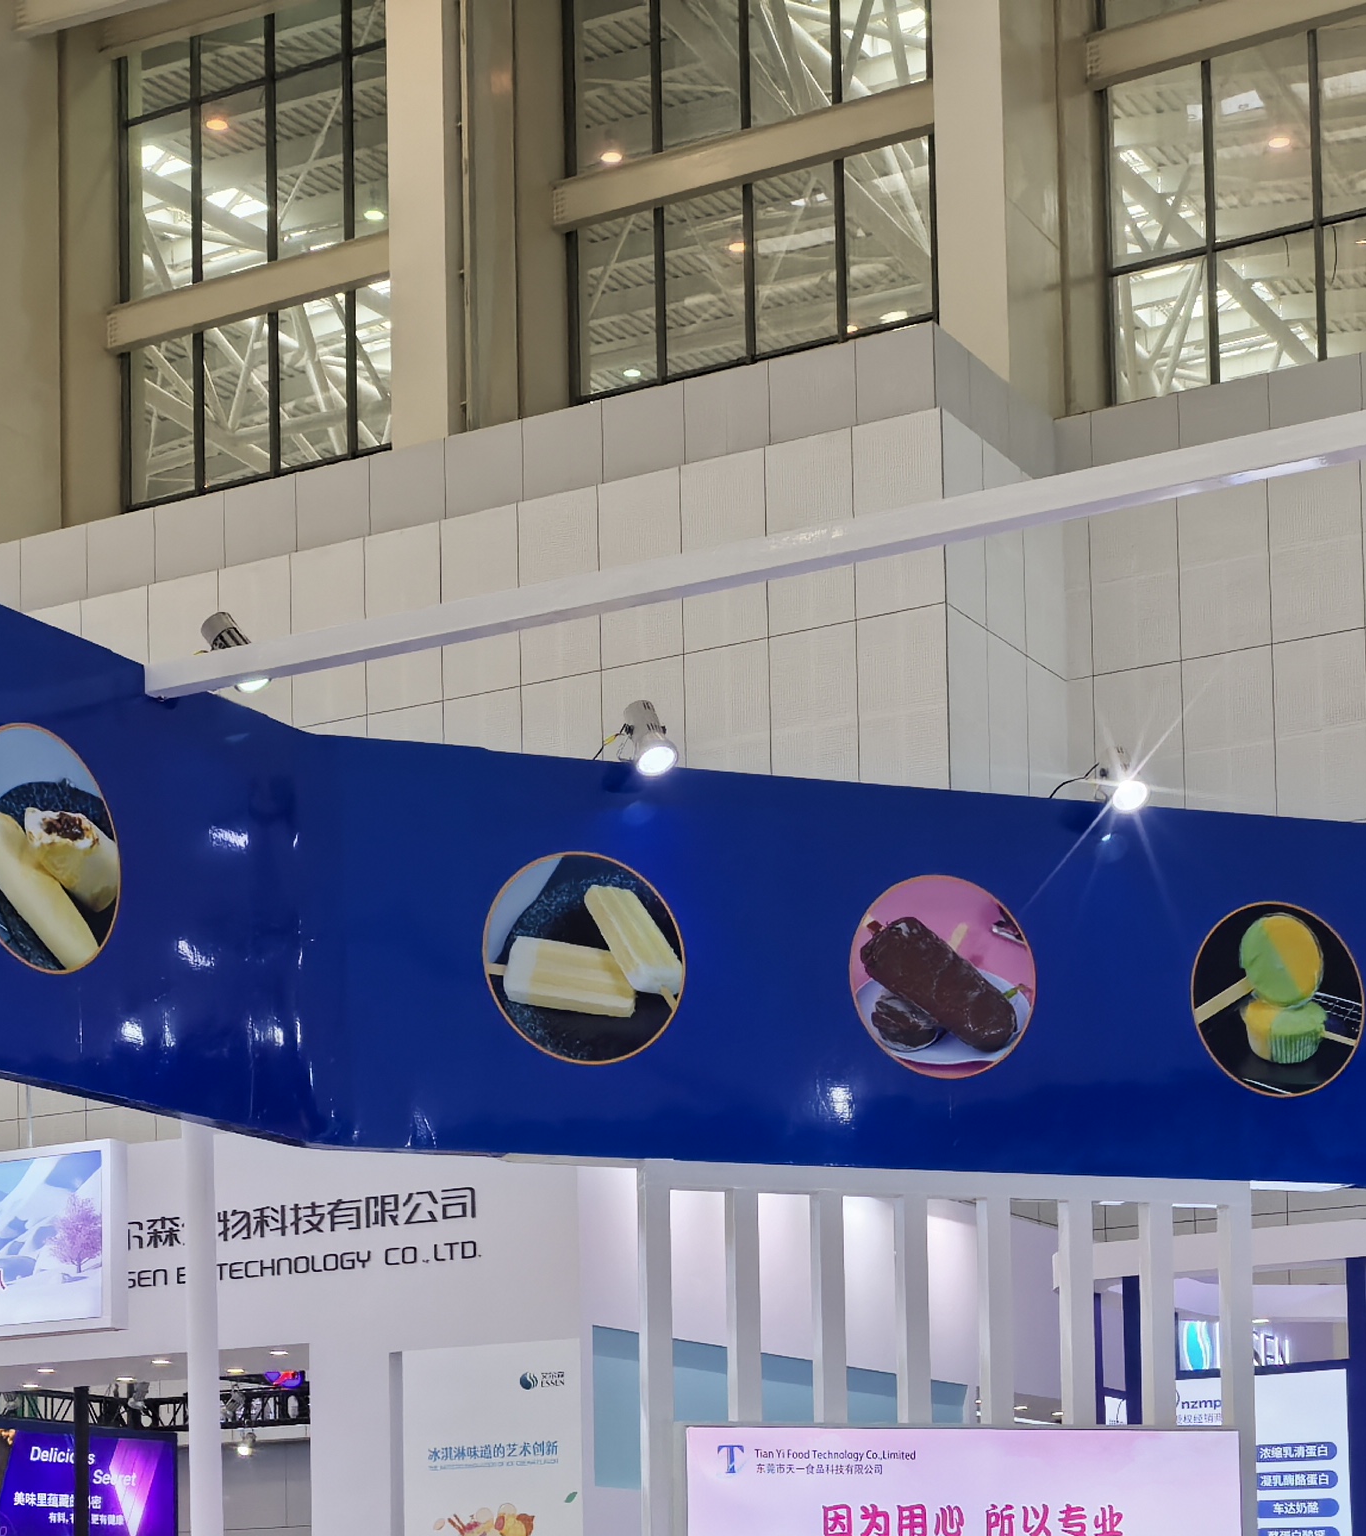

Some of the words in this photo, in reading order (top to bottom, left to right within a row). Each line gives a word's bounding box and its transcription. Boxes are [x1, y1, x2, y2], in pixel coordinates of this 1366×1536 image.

[1181, 1398, 1221, 1411] nzmp
[428, 1440, 559, 1463] 冰淇淋味道的艺术创新
[755, 1449, 774, 1459] Tian
[776, 1449, 785, 1459] Yi
[787, 1449, 809, 1460] Food
[812, 1449, 864, 1462] Technology
[865, 1450, 916, 1461] Co.,Limited
[1260, 1446, 1328, 1459] 浓缩乳清蛋白
[756, 1463, 883, 1475] 东莞市天一食品科技有限公司
[1273, 1502, 1319, 1515] 车达奶酪
